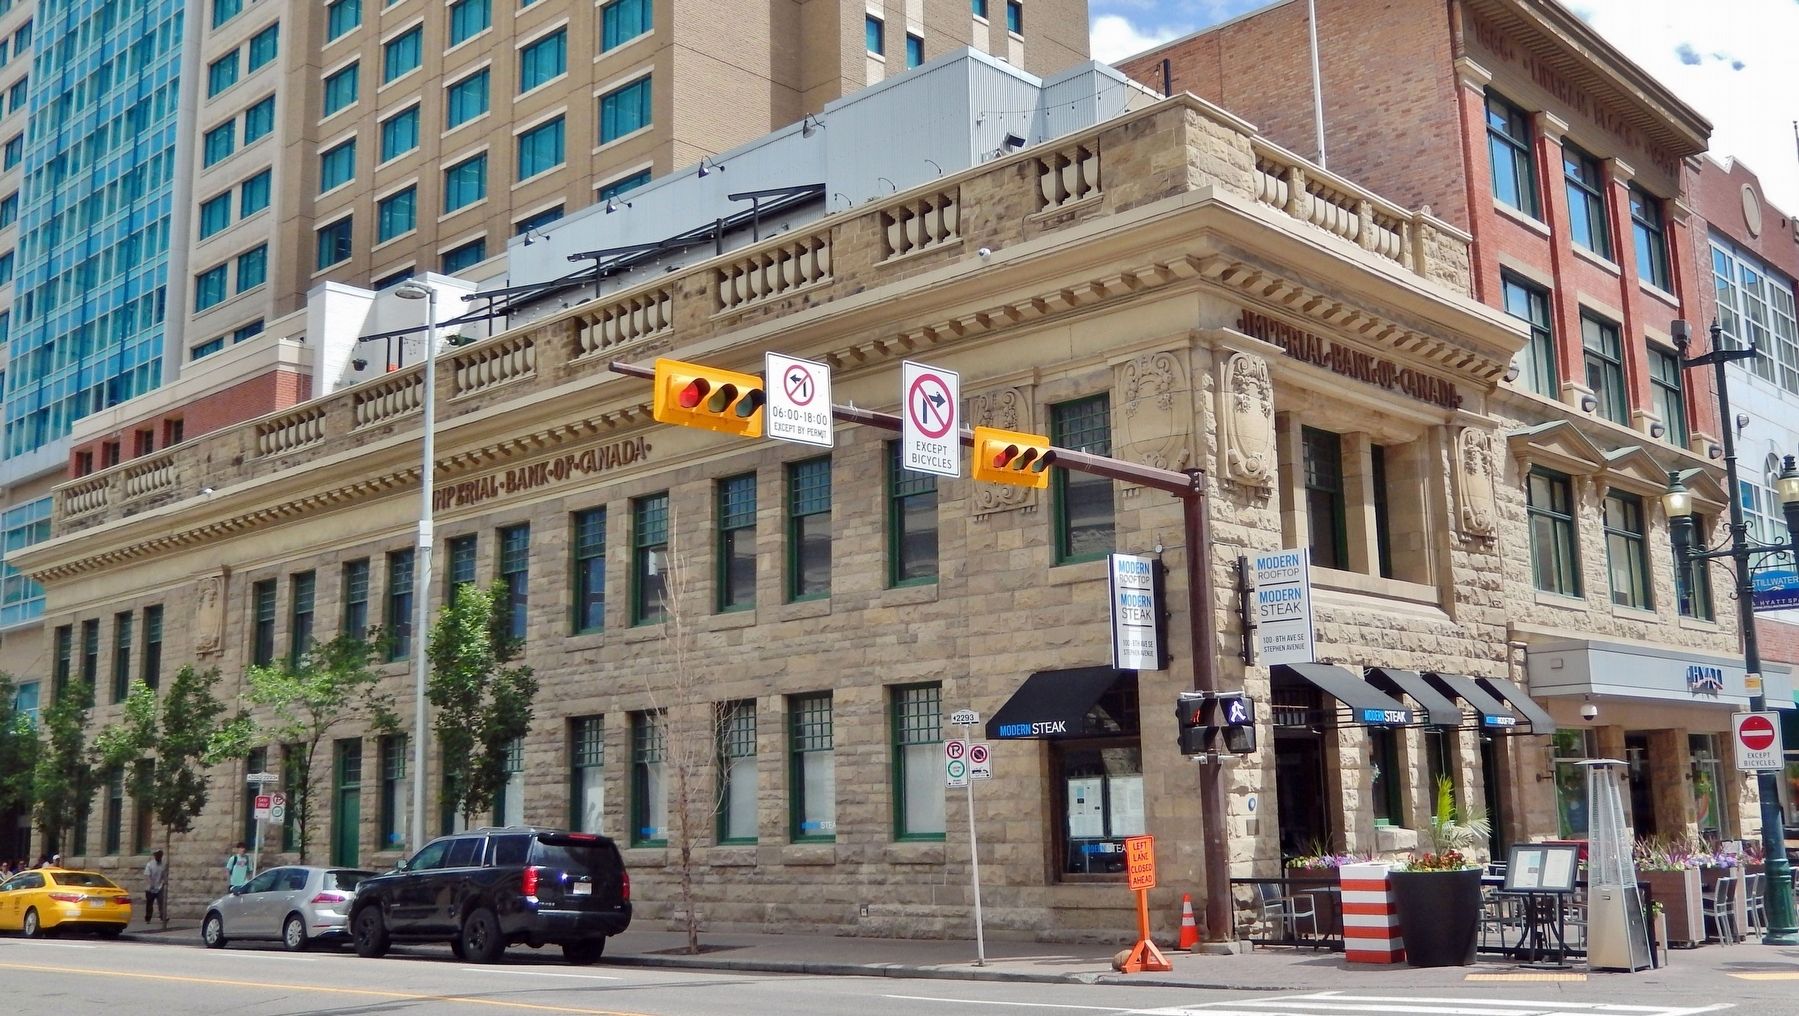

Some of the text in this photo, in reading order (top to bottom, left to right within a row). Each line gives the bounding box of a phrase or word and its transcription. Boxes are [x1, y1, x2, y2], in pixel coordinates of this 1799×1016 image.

[1330, 343, 1375, 383] BANK
[773, 406, 828, 426] 06:00-18:00
[774, 422, 826, 438] EXCEPT BY PERMIT
[916, 441, 947, 455] EXCEPT
[911, 455, 951, 469] BICYCLES
[433, 436, 648, 511] MPERIAL BANK OF CANADA
[1118, 560, 1149, 574] MODERN
[1257, 554, 1299, 569] MODERN
[1119, 574, 1149, 584] ROOFTOP
[1258, 568, 1299, 580] ROOFTOP
[1120, 593, 1151, 607] MODERN
[1259, 588, 1301, 602] MODERN
[1260, 602, 1301, 616] STEAK
[1760, 599, 1785, 607] HYATT
[1121, 607, 1151, 620] STEAK
[1263, 636, 1273, 644] 100
[1275, 635, 1286, 643] 8TH
[1286, 634, 1297, 642] AVE
[1297, 633, 1304, 641] SE
[1263, 643, 1304, 653] STEPHEN AVENUE
[956, 713, 974, 721] 2293
[1384, 710, 1406, 722] STEAK
[1000, 721, 1066, 736] MODERN STEAK
[1132, 841, 1146, 850] LEFT
[1132, 852, 1148, 861] LANE
[1131, 864, 1152, 873] CLOSED
[1132, 875, 1152, 884] AHEAD
